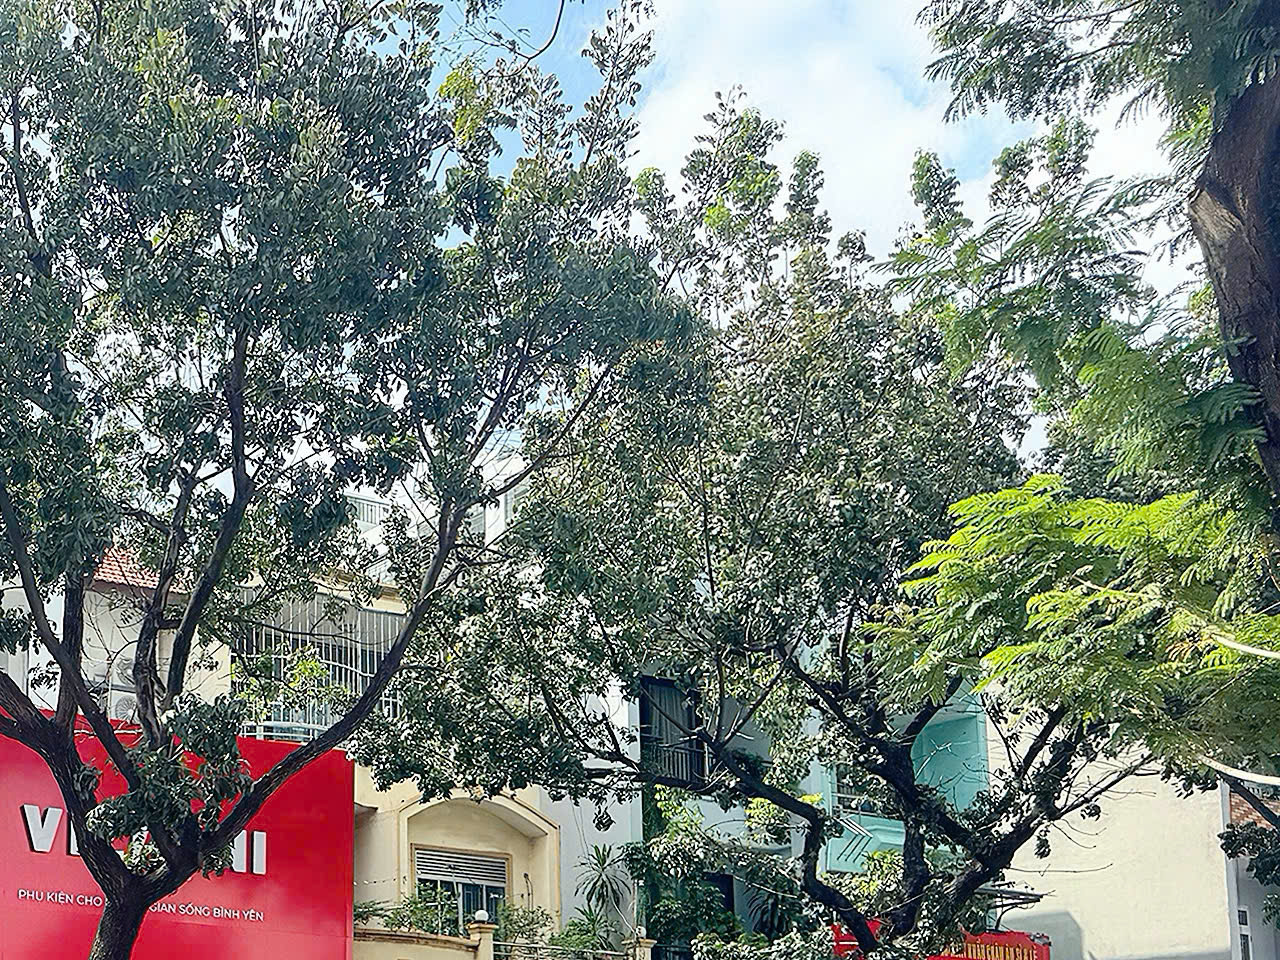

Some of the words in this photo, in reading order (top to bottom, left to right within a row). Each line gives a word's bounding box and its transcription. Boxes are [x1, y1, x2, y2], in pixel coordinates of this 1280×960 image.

[47, 891, 74, 905] KIỆN
[76, 895, 103, 907] CHO
[213, 906, 240, 919] BÌNH
[242, 909, 264, 922] YÊN
